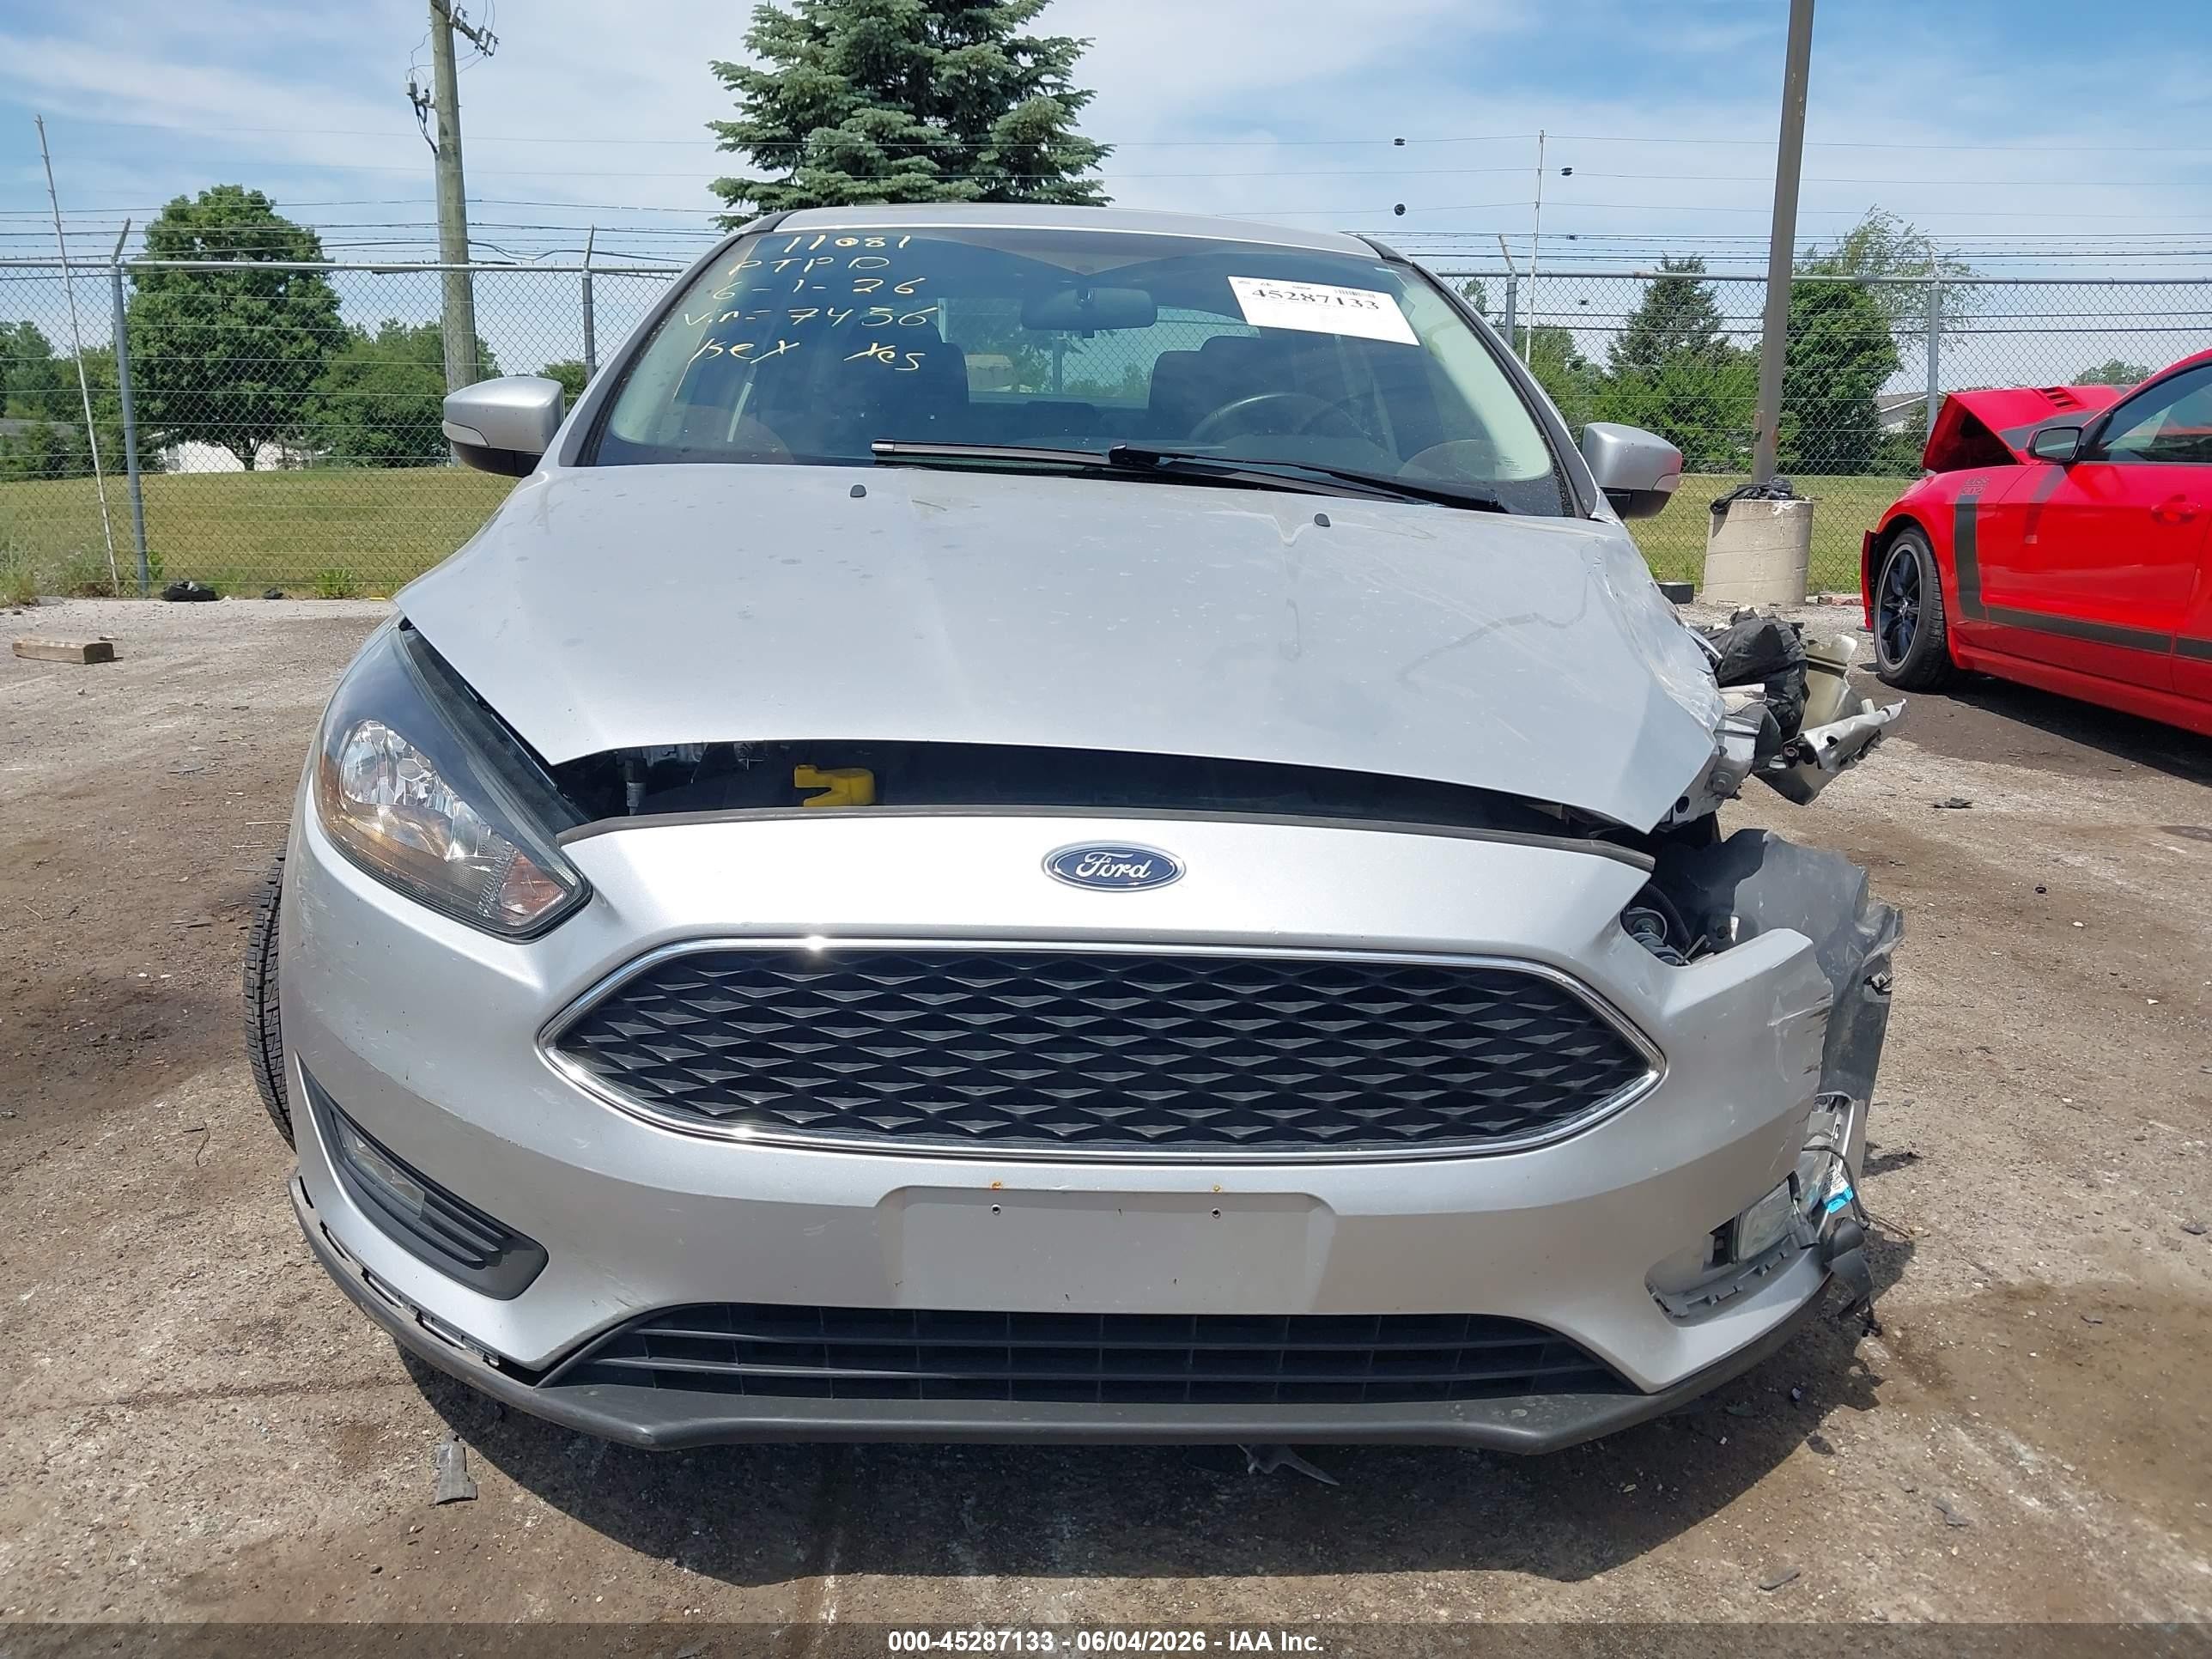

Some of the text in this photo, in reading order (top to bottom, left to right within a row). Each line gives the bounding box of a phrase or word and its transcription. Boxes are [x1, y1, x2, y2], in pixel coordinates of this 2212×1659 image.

[783, 234, 912, 253] 11081
[1252, 289, 1380, 310] 45287133
[1075, 851, 1153, 878] Ford
